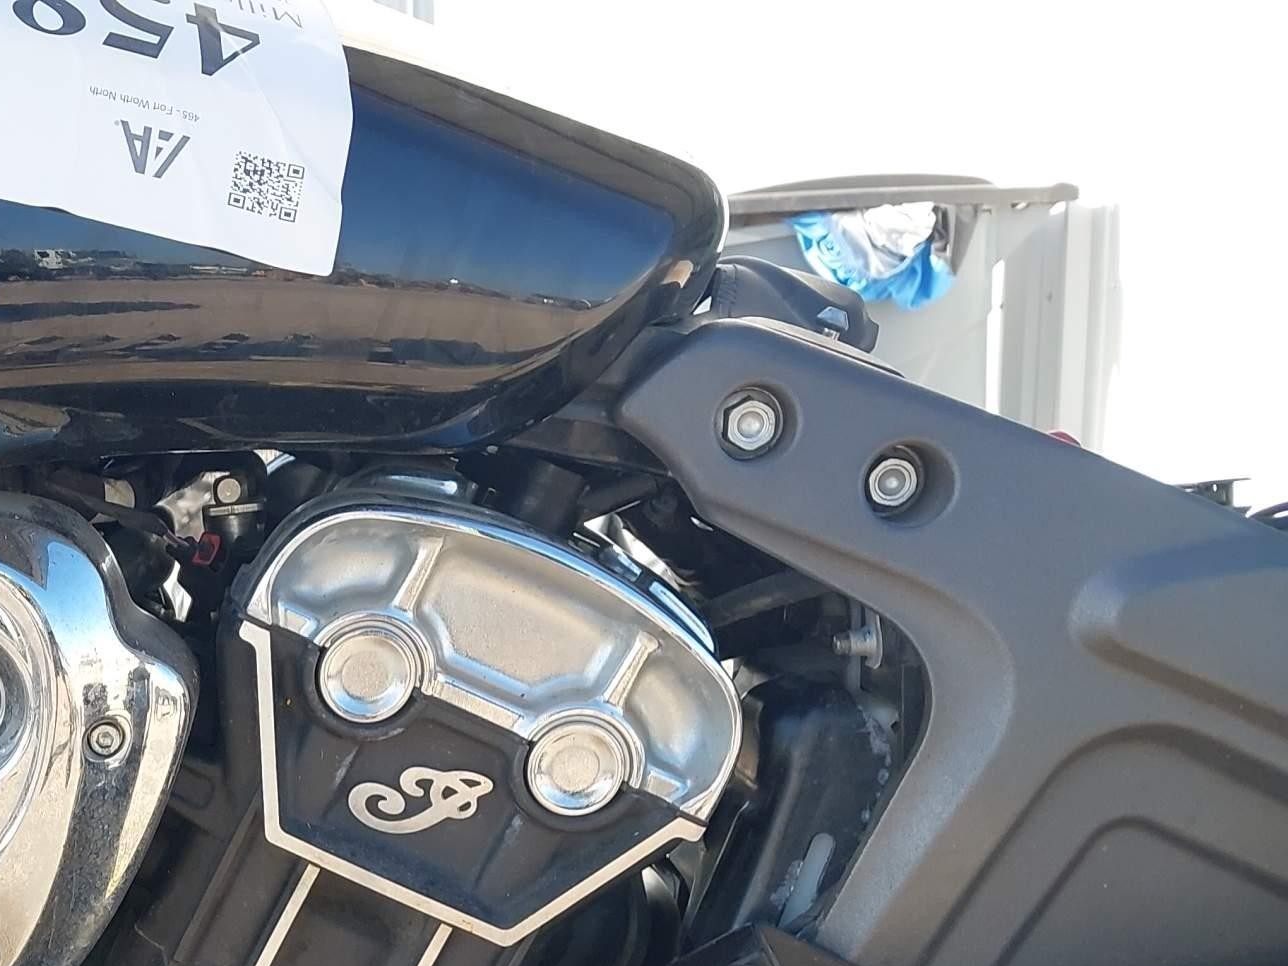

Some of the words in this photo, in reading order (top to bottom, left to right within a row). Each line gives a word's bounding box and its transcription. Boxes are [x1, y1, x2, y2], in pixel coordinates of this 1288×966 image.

[89, 85, 117, 100] North
[120, 93, 149, 110] Worth
[153, 102, 173, 115] Fort
[182, 109, 200, 122] 465
